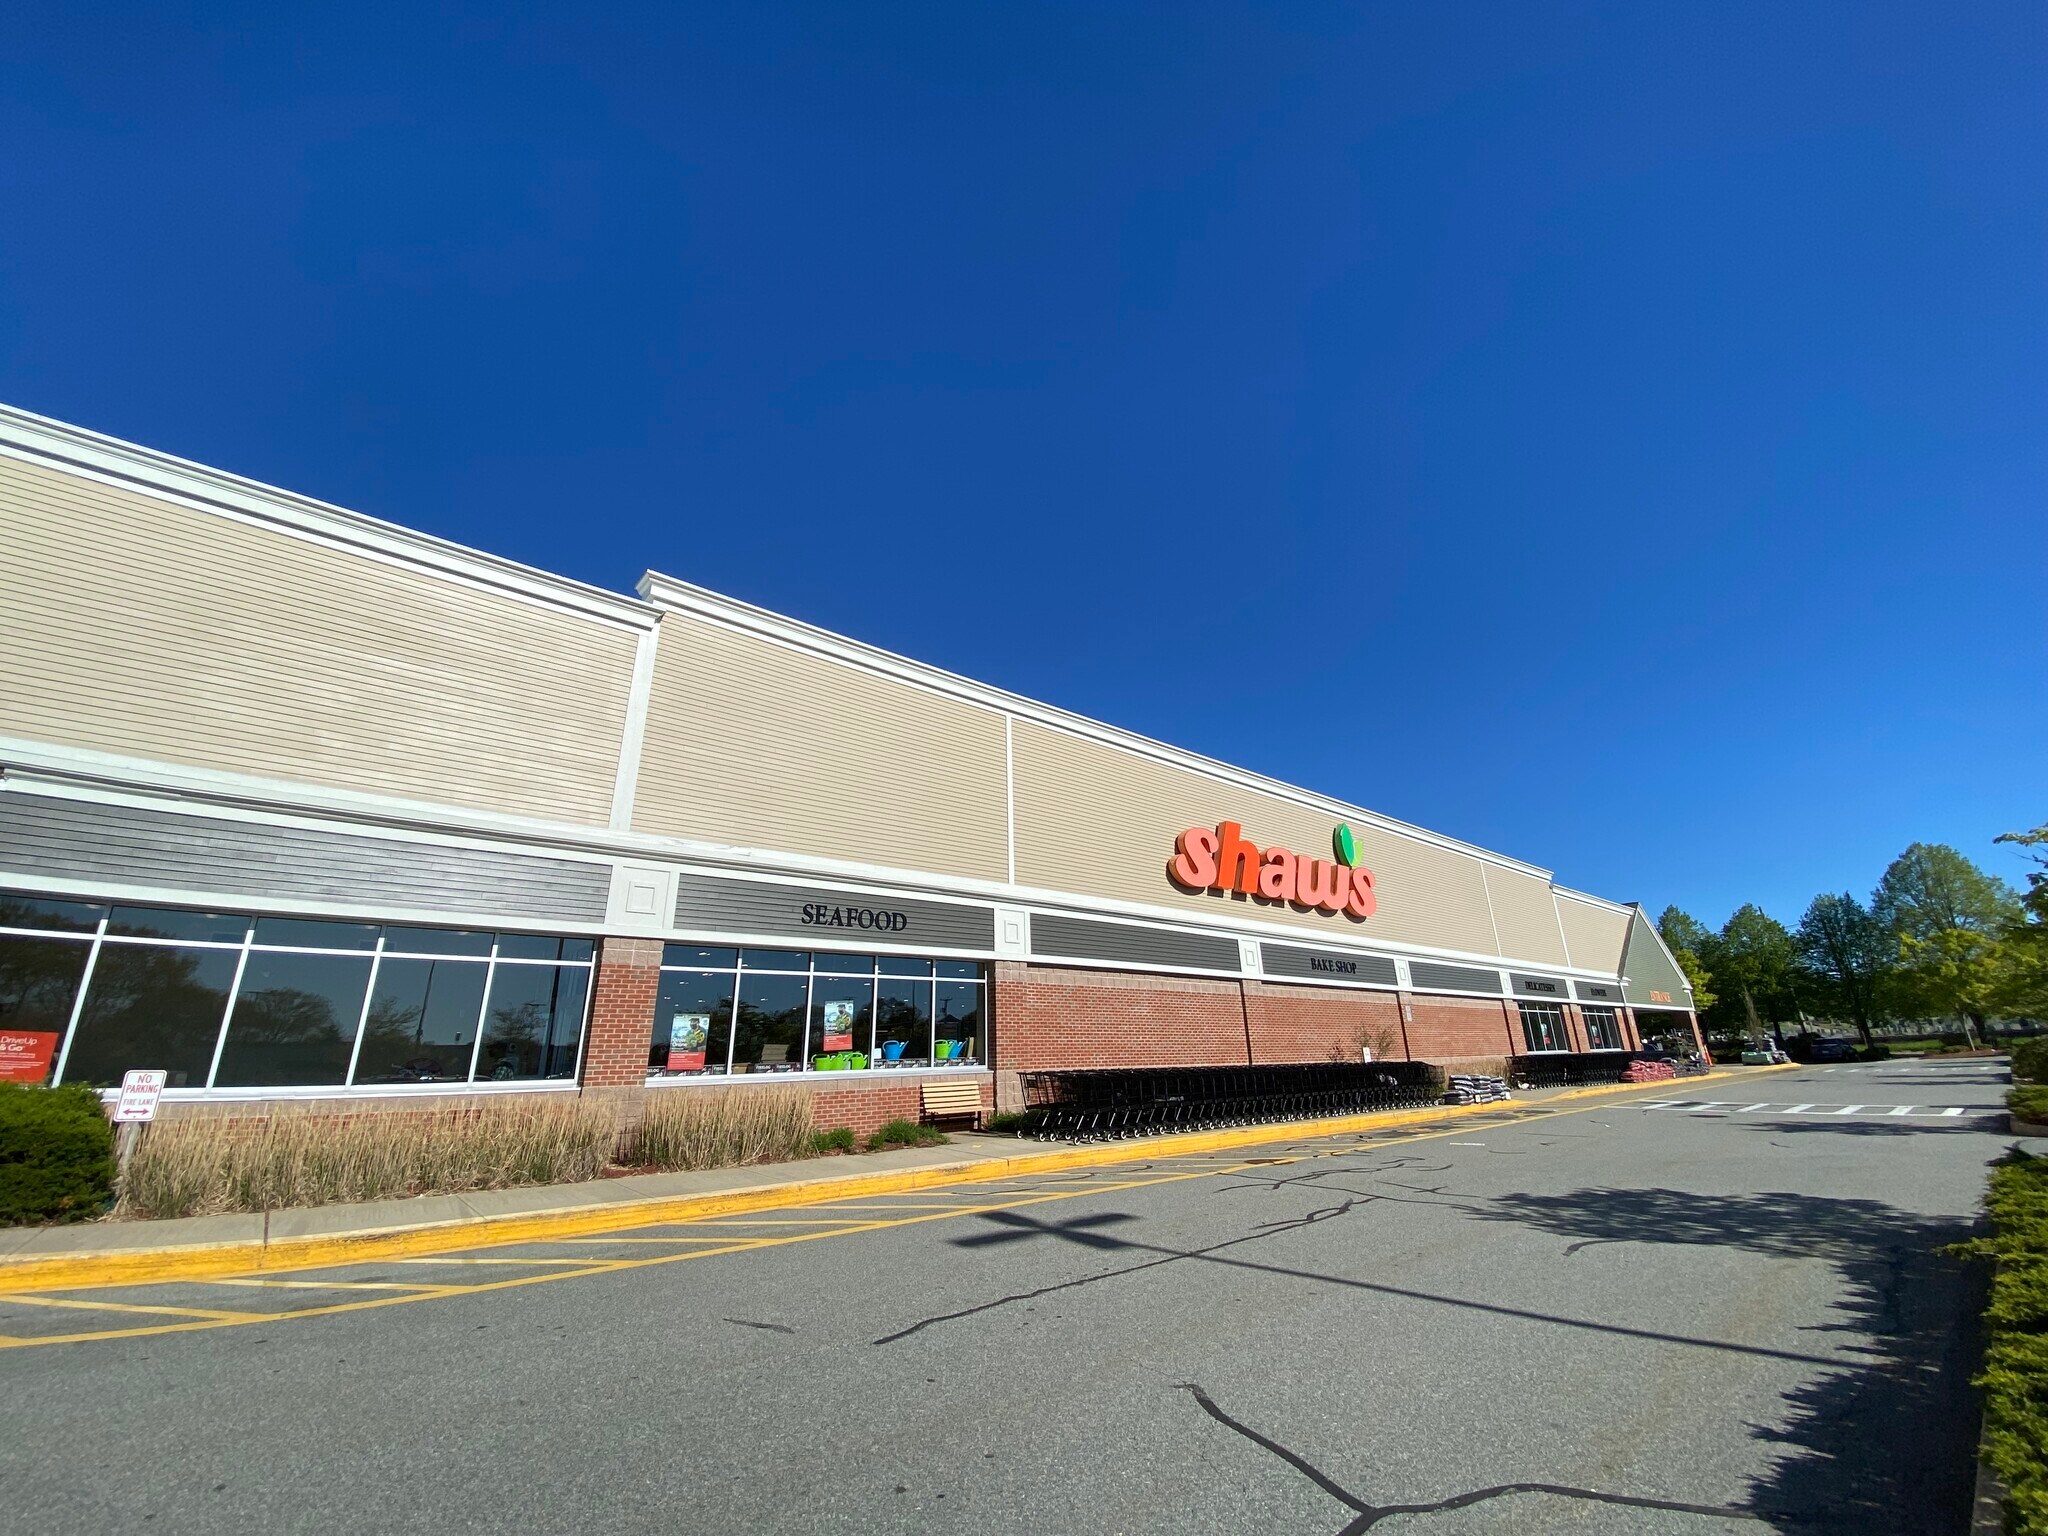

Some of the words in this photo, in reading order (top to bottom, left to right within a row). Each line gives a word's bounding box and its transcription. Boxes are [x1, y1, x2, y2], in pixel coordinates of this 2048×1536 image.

[801, 903, 907, 931] SEAFOOD
[1310, 957, 1335, 972] BAKE
[1335, 960, 1357, 974] SHOP
[1, 1036, 38, 1046] DriveUp
[137, 1074, 153, 1084] NO
[126, 1084, 159, 1093] PARKING
[123, 1098, 137, 1106] FIRE
[138, 1098, 155, 1106] LANE
